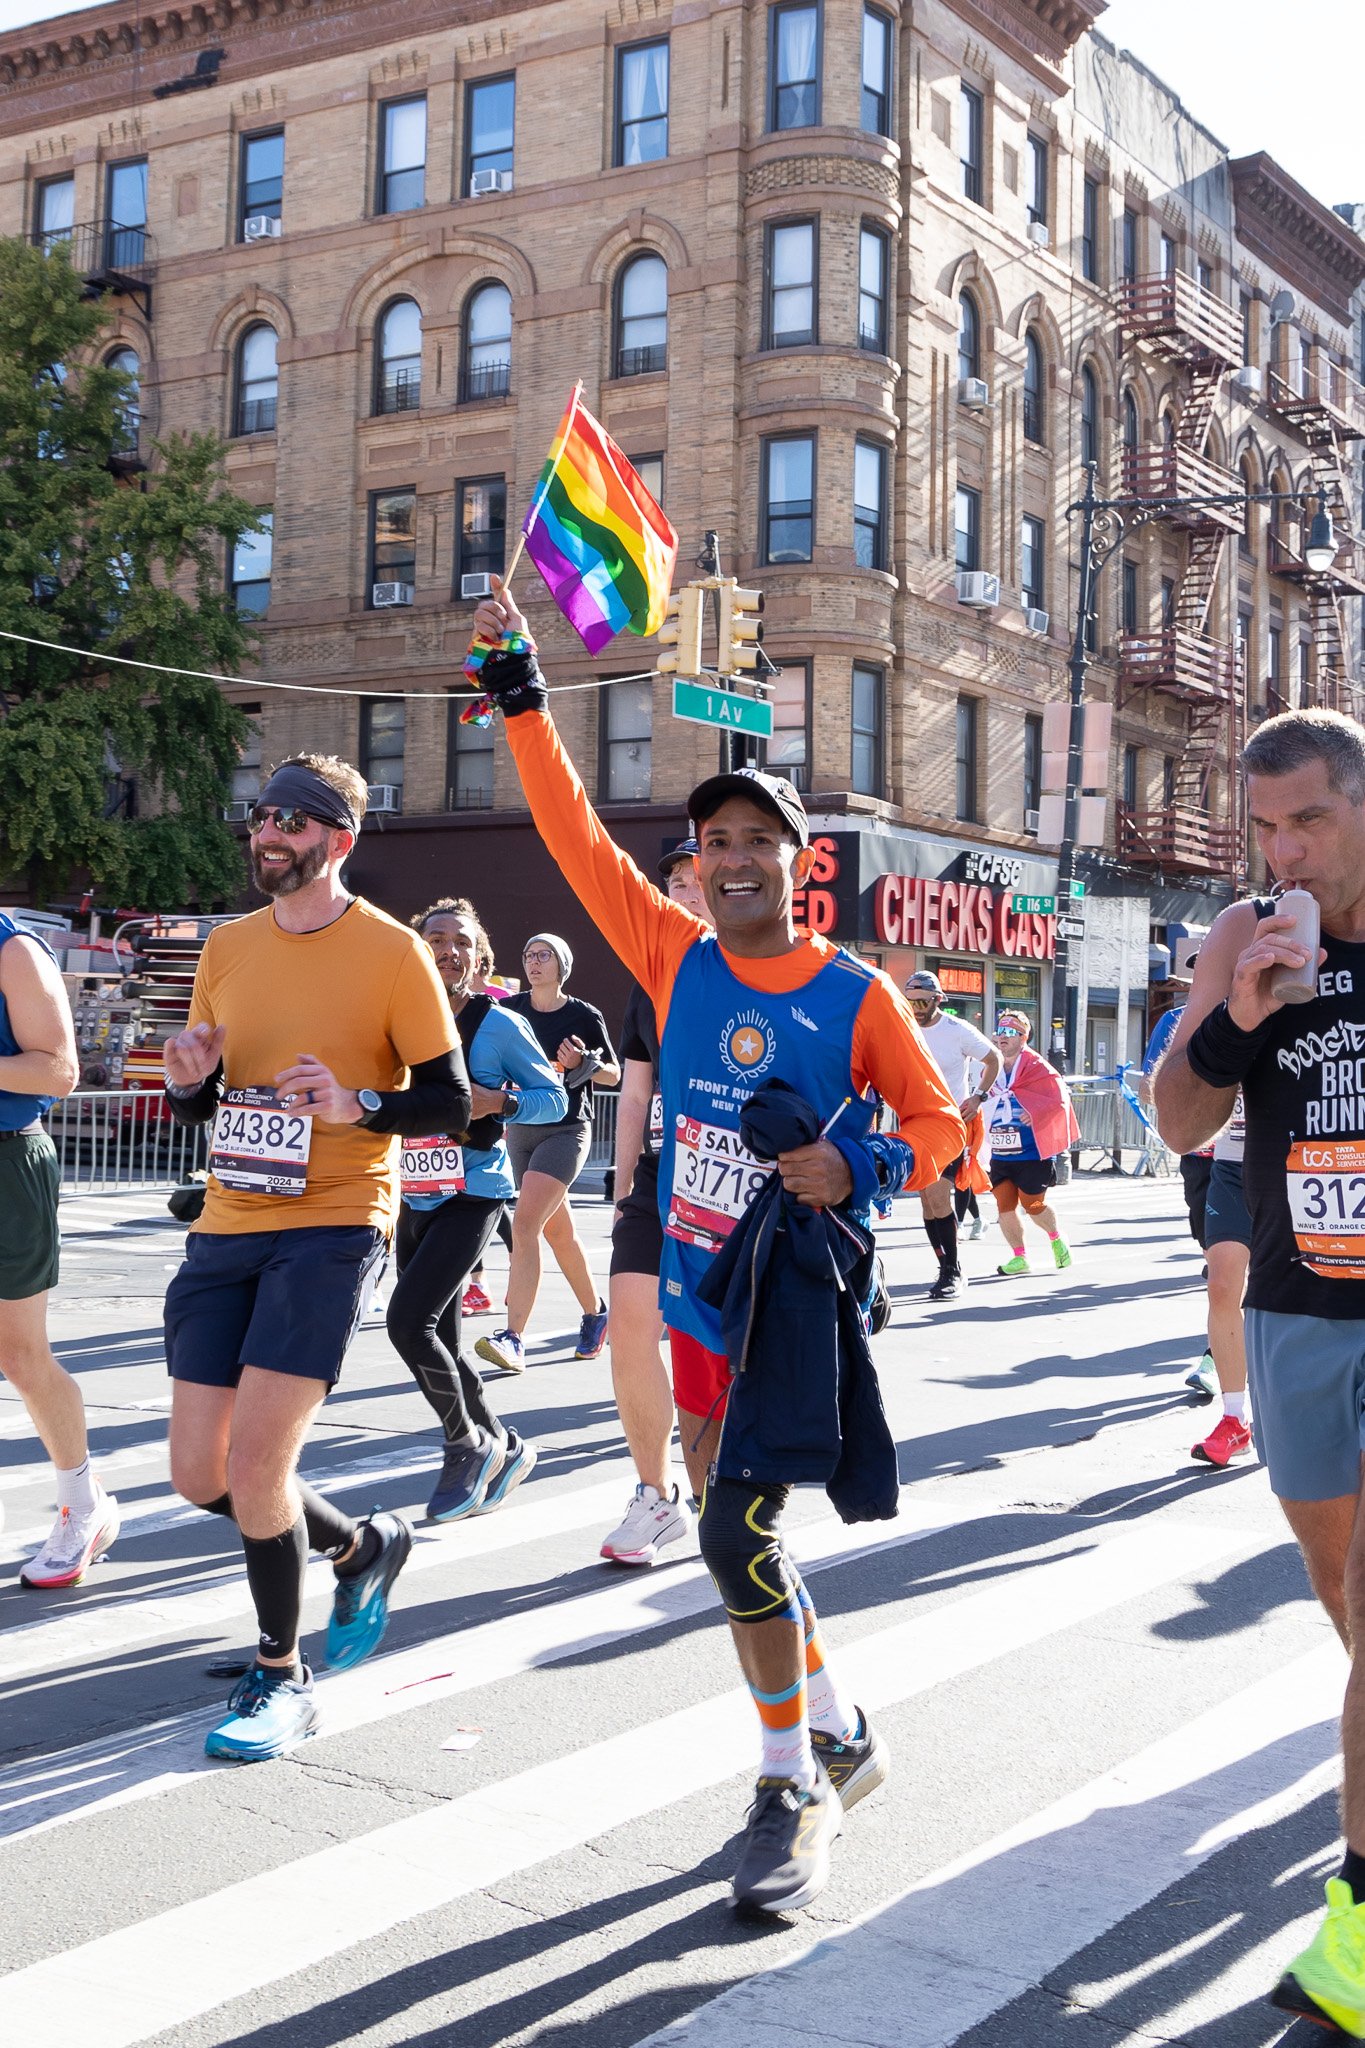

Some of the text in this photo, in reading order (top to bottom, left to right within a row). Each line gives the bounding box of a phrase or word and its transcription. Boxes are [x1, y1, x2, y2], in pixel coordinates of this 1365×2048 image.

[706, 695, 743, 723] 1 Av
[978, 852, 1024, 887] CFSC
[877, 872, 993, 954] CHECKS
[1016, 897, 1023, 911] E
[1026, 897, 1041, 912] 116
[1315, 970, 1353, 998] EG
[688, 1077, 730, 1097] FRONT
[711, 1098, 735, 1112] NEW
[218, 1109, 305, 1151] 34382
[258, 1147, 265, 1155] D
[1302, 1146, 1334, 1167] tcs
[267, 1176, 292, 1186] 2024
[685, 1151, 769, 1206] 31718
[723, 1203, 730, 1212] B
[1302, 1177, 1365, 1219] 312
[1317, 1221, 1325, 1231] 3
